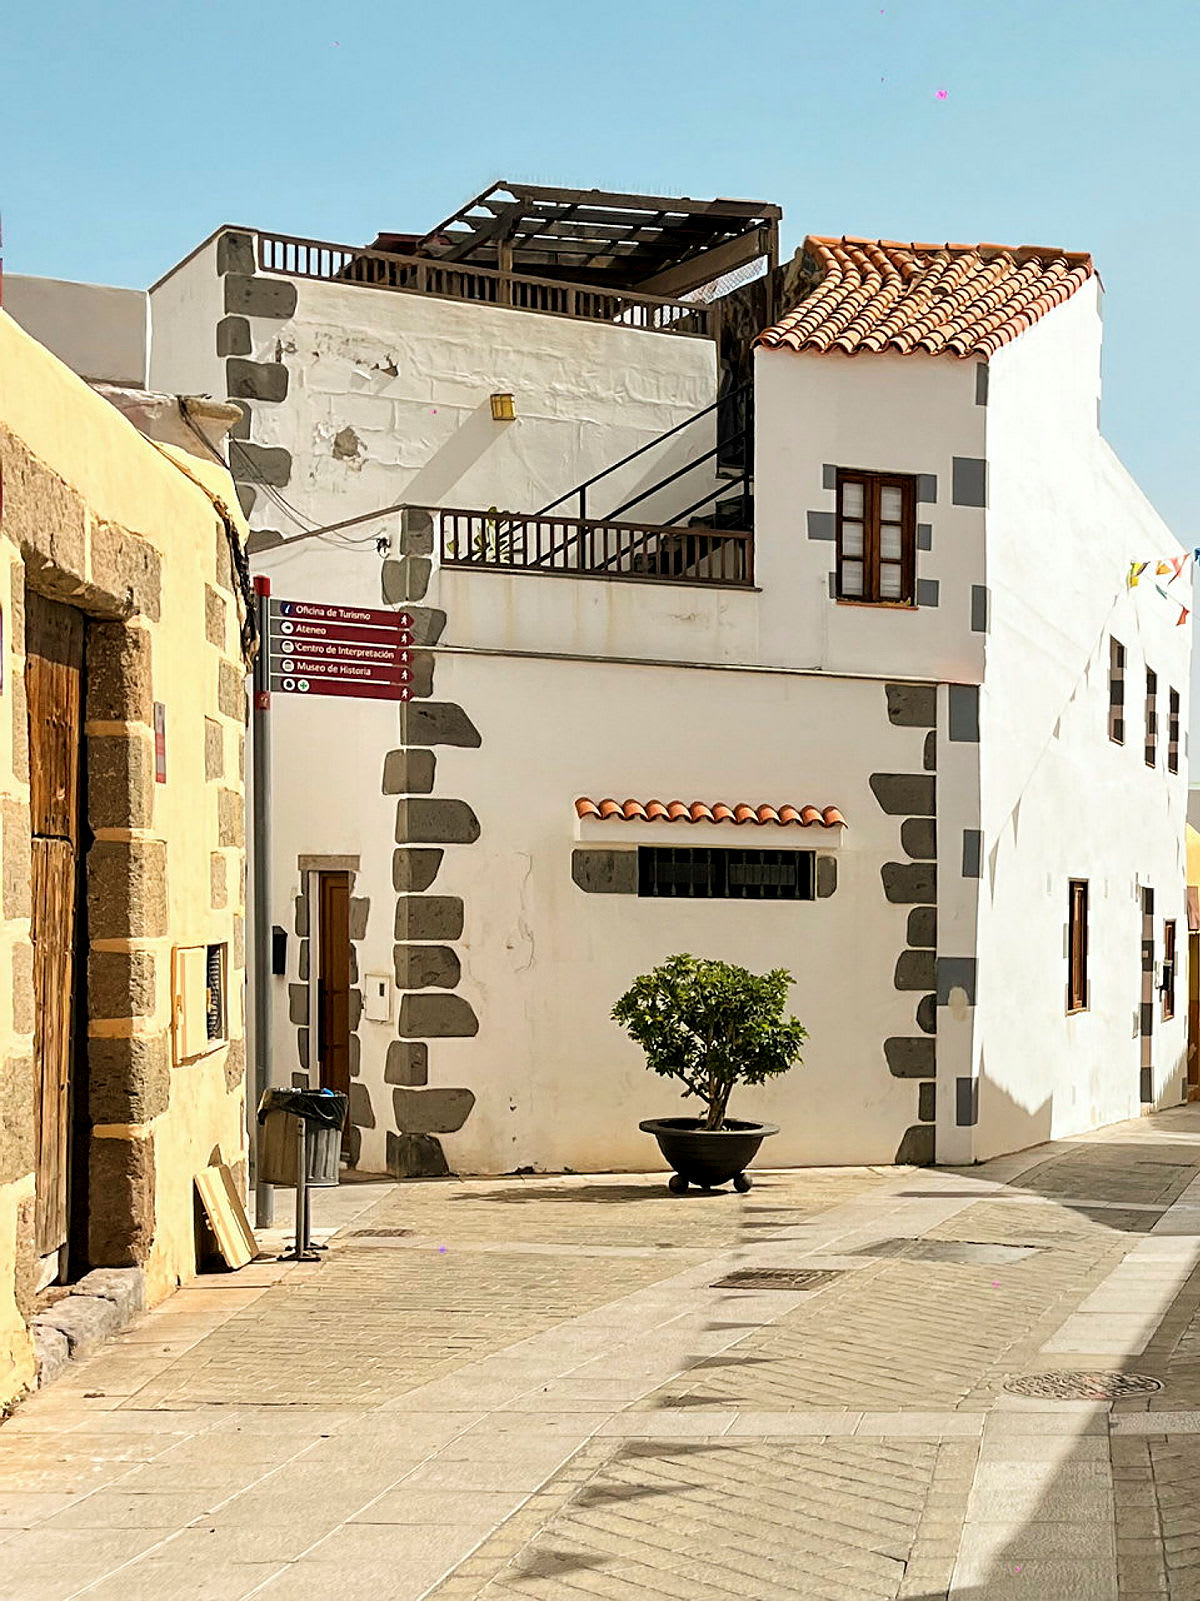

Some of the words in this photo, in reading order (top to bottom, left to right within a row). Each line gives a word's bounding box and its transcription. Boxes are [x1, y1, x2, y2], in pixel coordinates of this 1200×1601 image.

[296, 607, 325, 617] Oficina
[326, 608, 337, 618] de
[339, 610, 371, 621] Turismo
[295, 624, 327, 635] Ateneo
[296, 643, 325, 653] Centro
[326, 645, 337, 654] de
[338, 646, 394, 660] Interpretación
[297, 662, 326, 672] Museo
[327, 664, 338, 674] de
[340, 666, 371, 676] Historia
